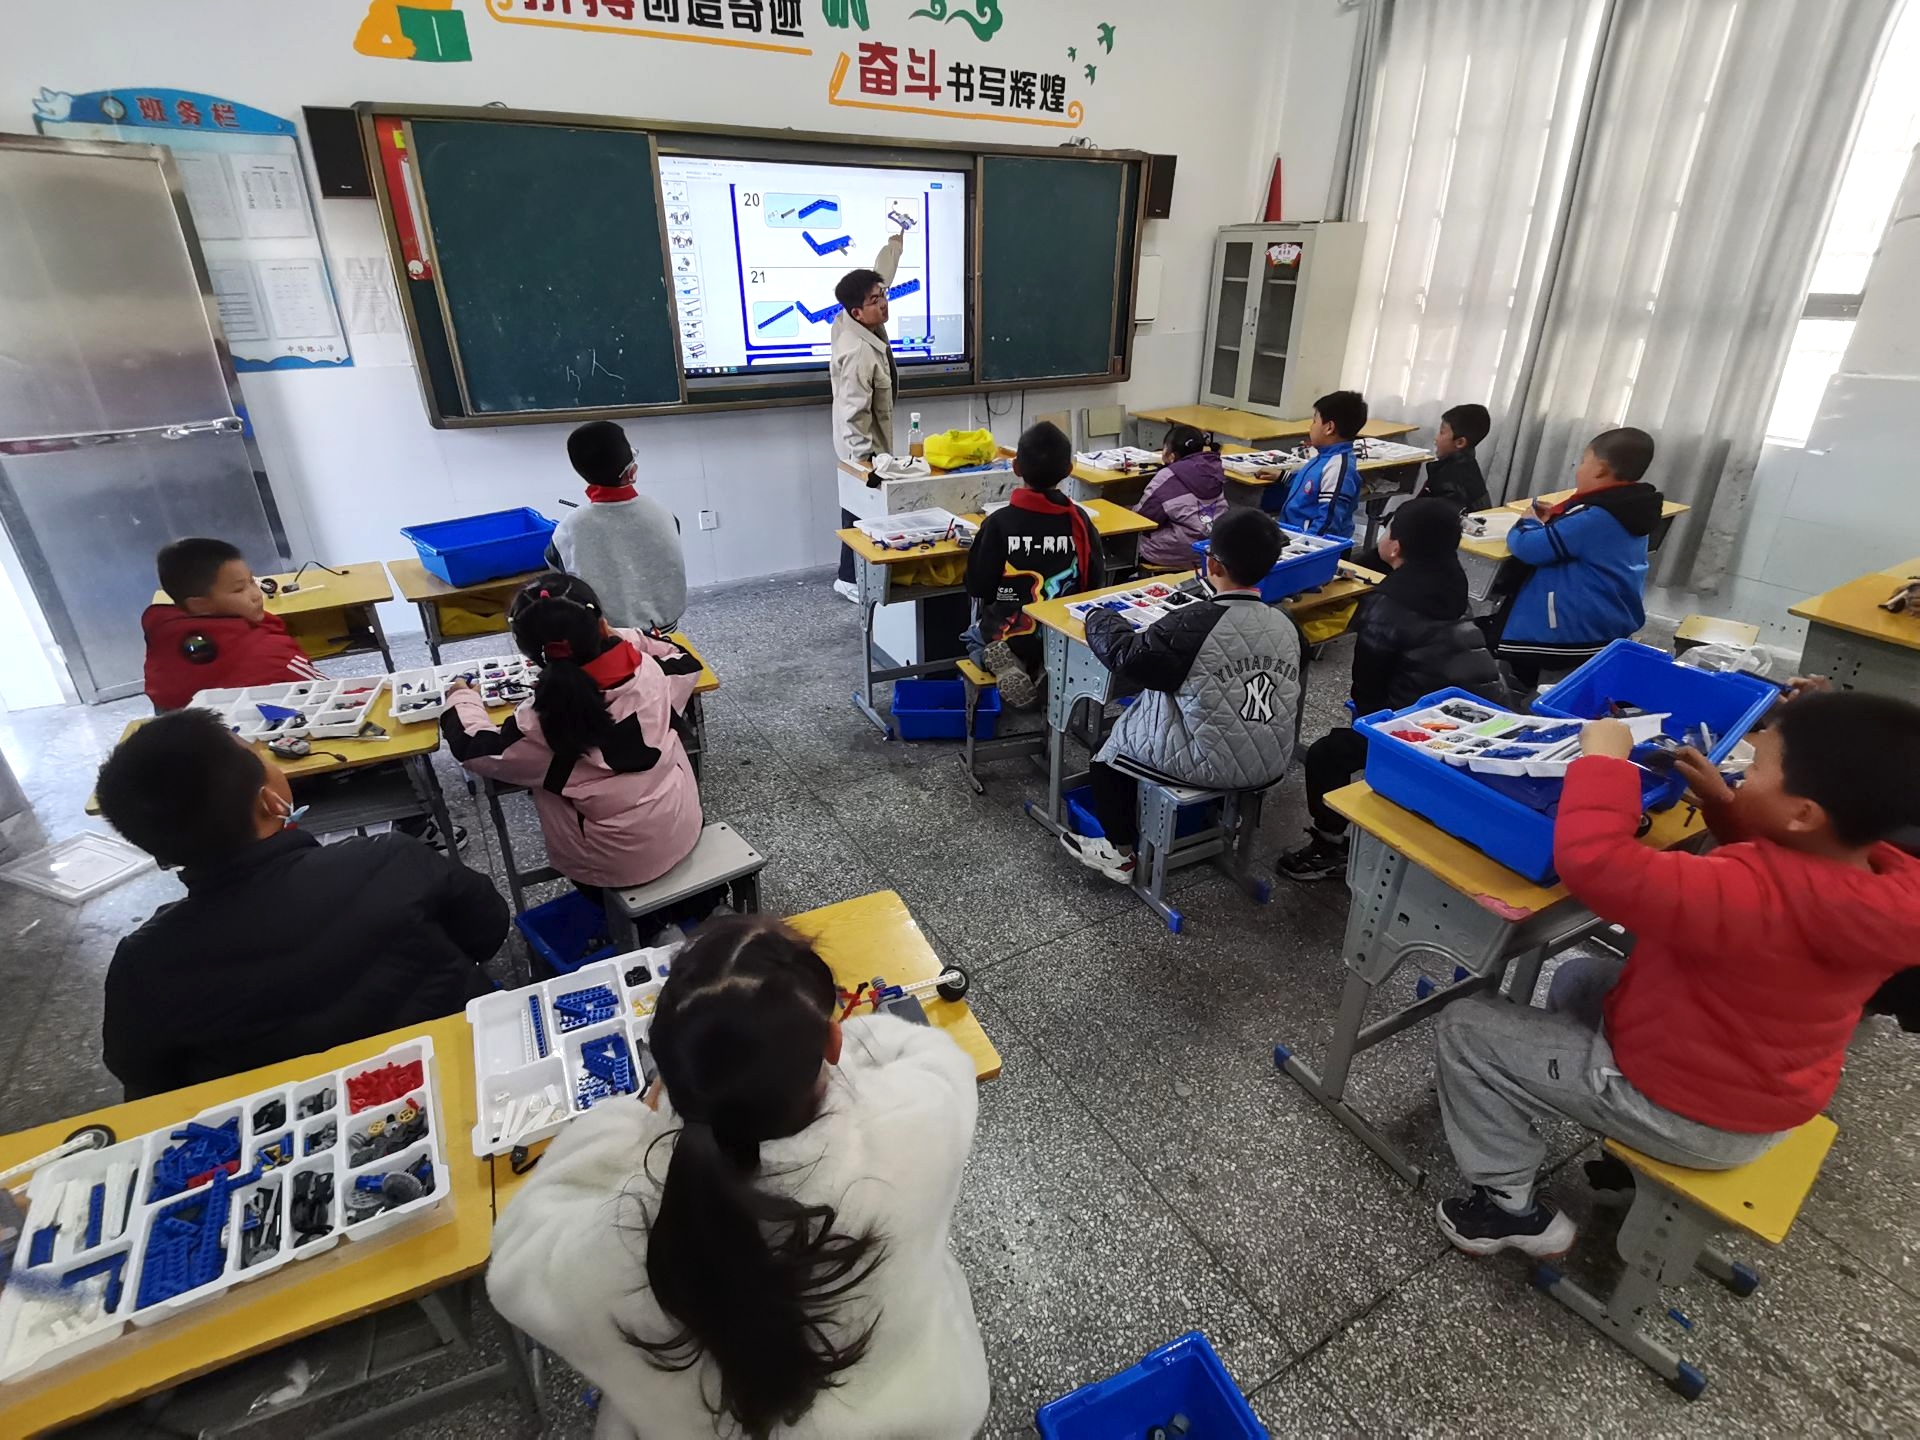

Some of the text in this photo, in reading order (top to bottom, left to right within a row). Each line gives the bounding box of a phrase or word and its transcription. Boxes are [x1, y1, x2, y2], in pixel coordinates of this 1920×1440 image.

[858, 41, 1067, 114] 奋斗书写辉煌
[136, 97, 241, 128] 班务栏
[743, 191, 761, 208] 20
[750, 270, 766, 284] 21
[1239, 671, 1277, 725] NY
